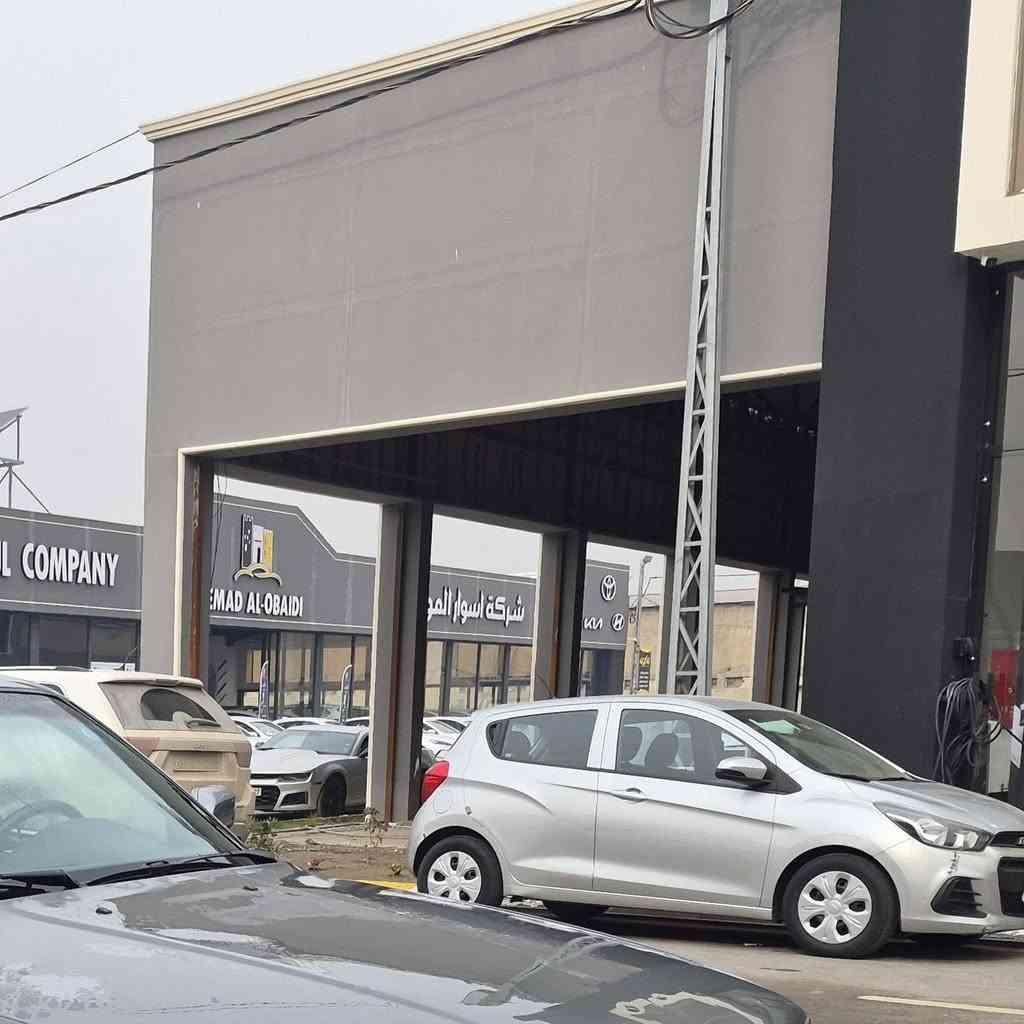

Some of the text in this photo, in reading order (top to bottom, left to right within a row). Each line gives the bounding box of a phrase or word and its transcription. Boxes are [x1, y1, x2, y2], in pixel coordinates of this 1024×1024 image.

[22, 543, 120, 586] COMPANY
[246, 592, 304, 617] AL-OBAIDI
[452, 586, 484, 624] اسوار
[485, 594, 525, 628] شركة
